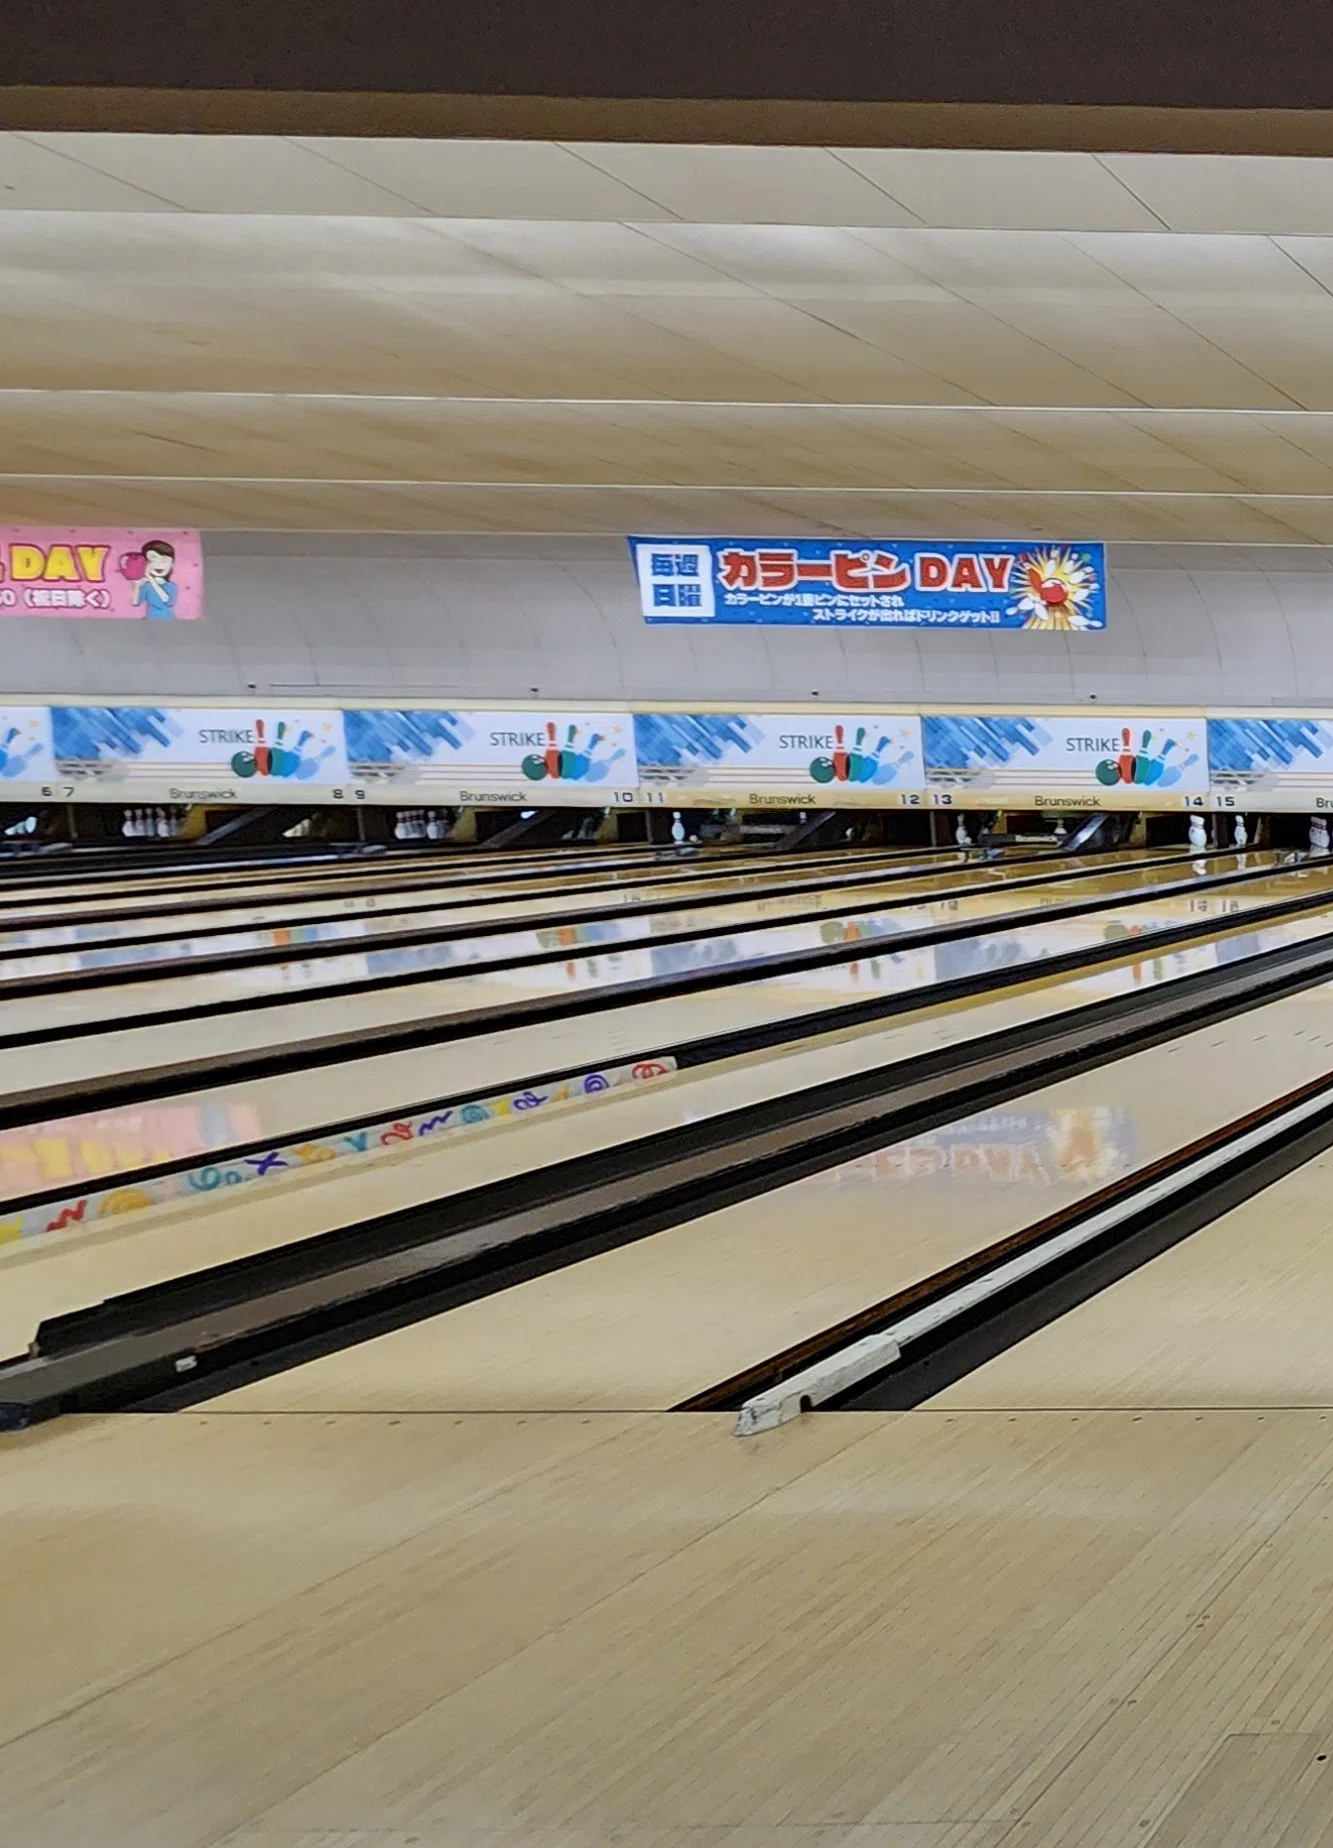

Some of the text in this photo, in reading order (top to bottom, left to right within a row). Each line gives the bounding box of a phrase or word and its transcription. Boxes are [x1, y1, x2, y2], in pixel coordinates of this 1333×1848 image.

[9, 543, 111, 581] DAY
[651, 553, 700, 577] 毎週
[717, 549, 1015, 592] カラーピン DAY
[198, 729, 254, 744] STRIKE
[490, 731, 546, 747] STRIKE
[779, 734, 833, 750] STRIKE
[1066, 737, 1120, 752] STRIKE
[41, 786, 53, 797] 6
[62, 786, 75, 798] 7
[169, 788, 238, 801] Brunswick
[332, 788, 344, 800] 8
[354, 789, 366, 800] 9
[459, 790, 528, 802] Brunswick
[614, 791, 634, 803] 10
[646, 793, 664, 804] 11
[749, 793, 817, 805] Brunswick
[901, 794, 921, 805] 12
[933, 794, 953, 805] 13
[1034, 795, 1101, 807] Brunswick
[1185, 796, 1204, 807] 14
[1216, 796, 1235, 807] 15
